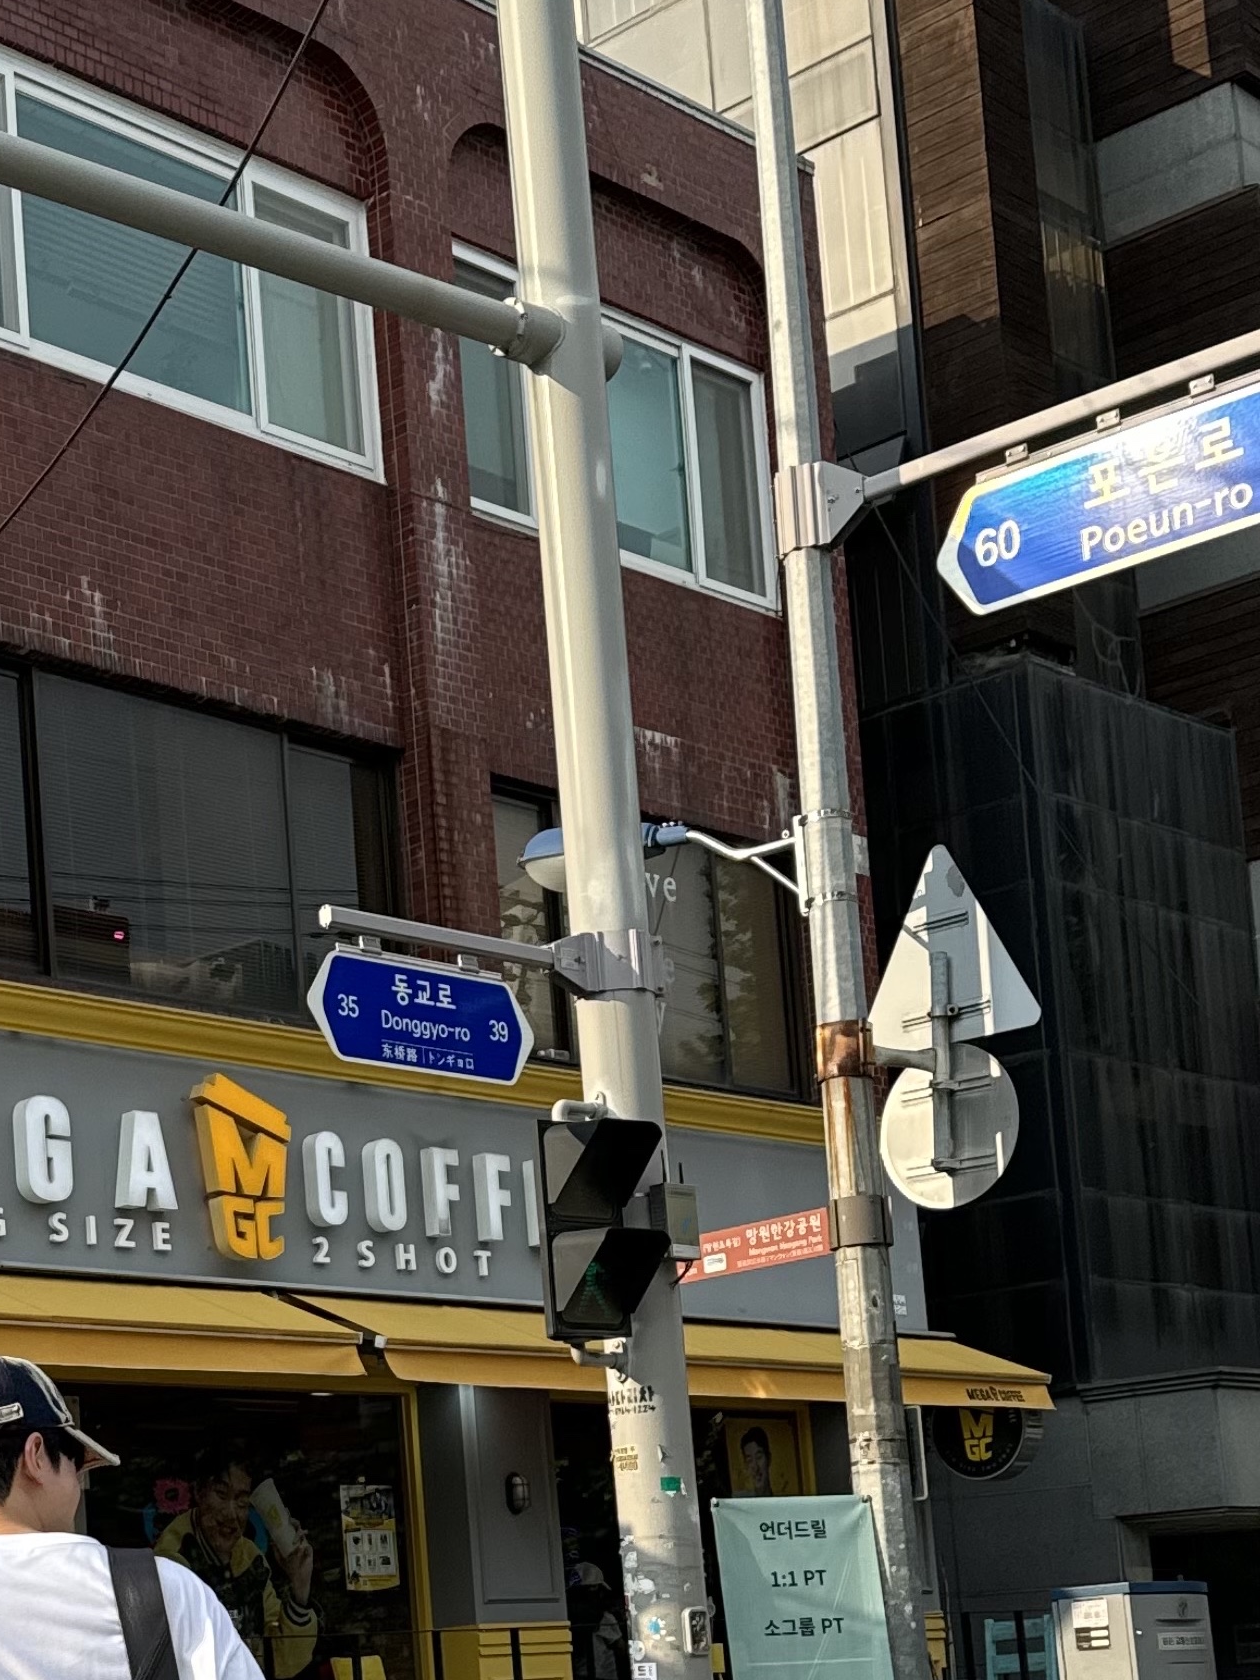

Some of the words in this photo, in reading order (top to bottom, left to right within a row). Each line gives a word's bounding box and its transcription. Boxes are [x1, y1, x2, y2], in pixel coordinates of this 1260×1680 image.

[1084, 417, 1244, 509] 포은로
[1080, 483, 1253, 561] Poeun-ro
[975, 519, 1021, 566] 60
[337, 994, 359, 1017] 35
[391, 974, 456, 1009] 동교로
[381, 1009, 470, 1041] Donggyo-ro
[489, 1020, 508, 1042] 39
[302, 1131, 540, 1248] COFF
[48, 1211, 172, 1251] SIZE
[745, 1213, 821, 1246] 망원한강공원
[759, 1519, 827, 1541] 언더드릴
[771, 1571, 798, 1588] 1:1
[804, 1569, 827, 1586] PT
[764, 1618, 816, 1637] 소그룹
[821, 1617, 844, 1634] PT
